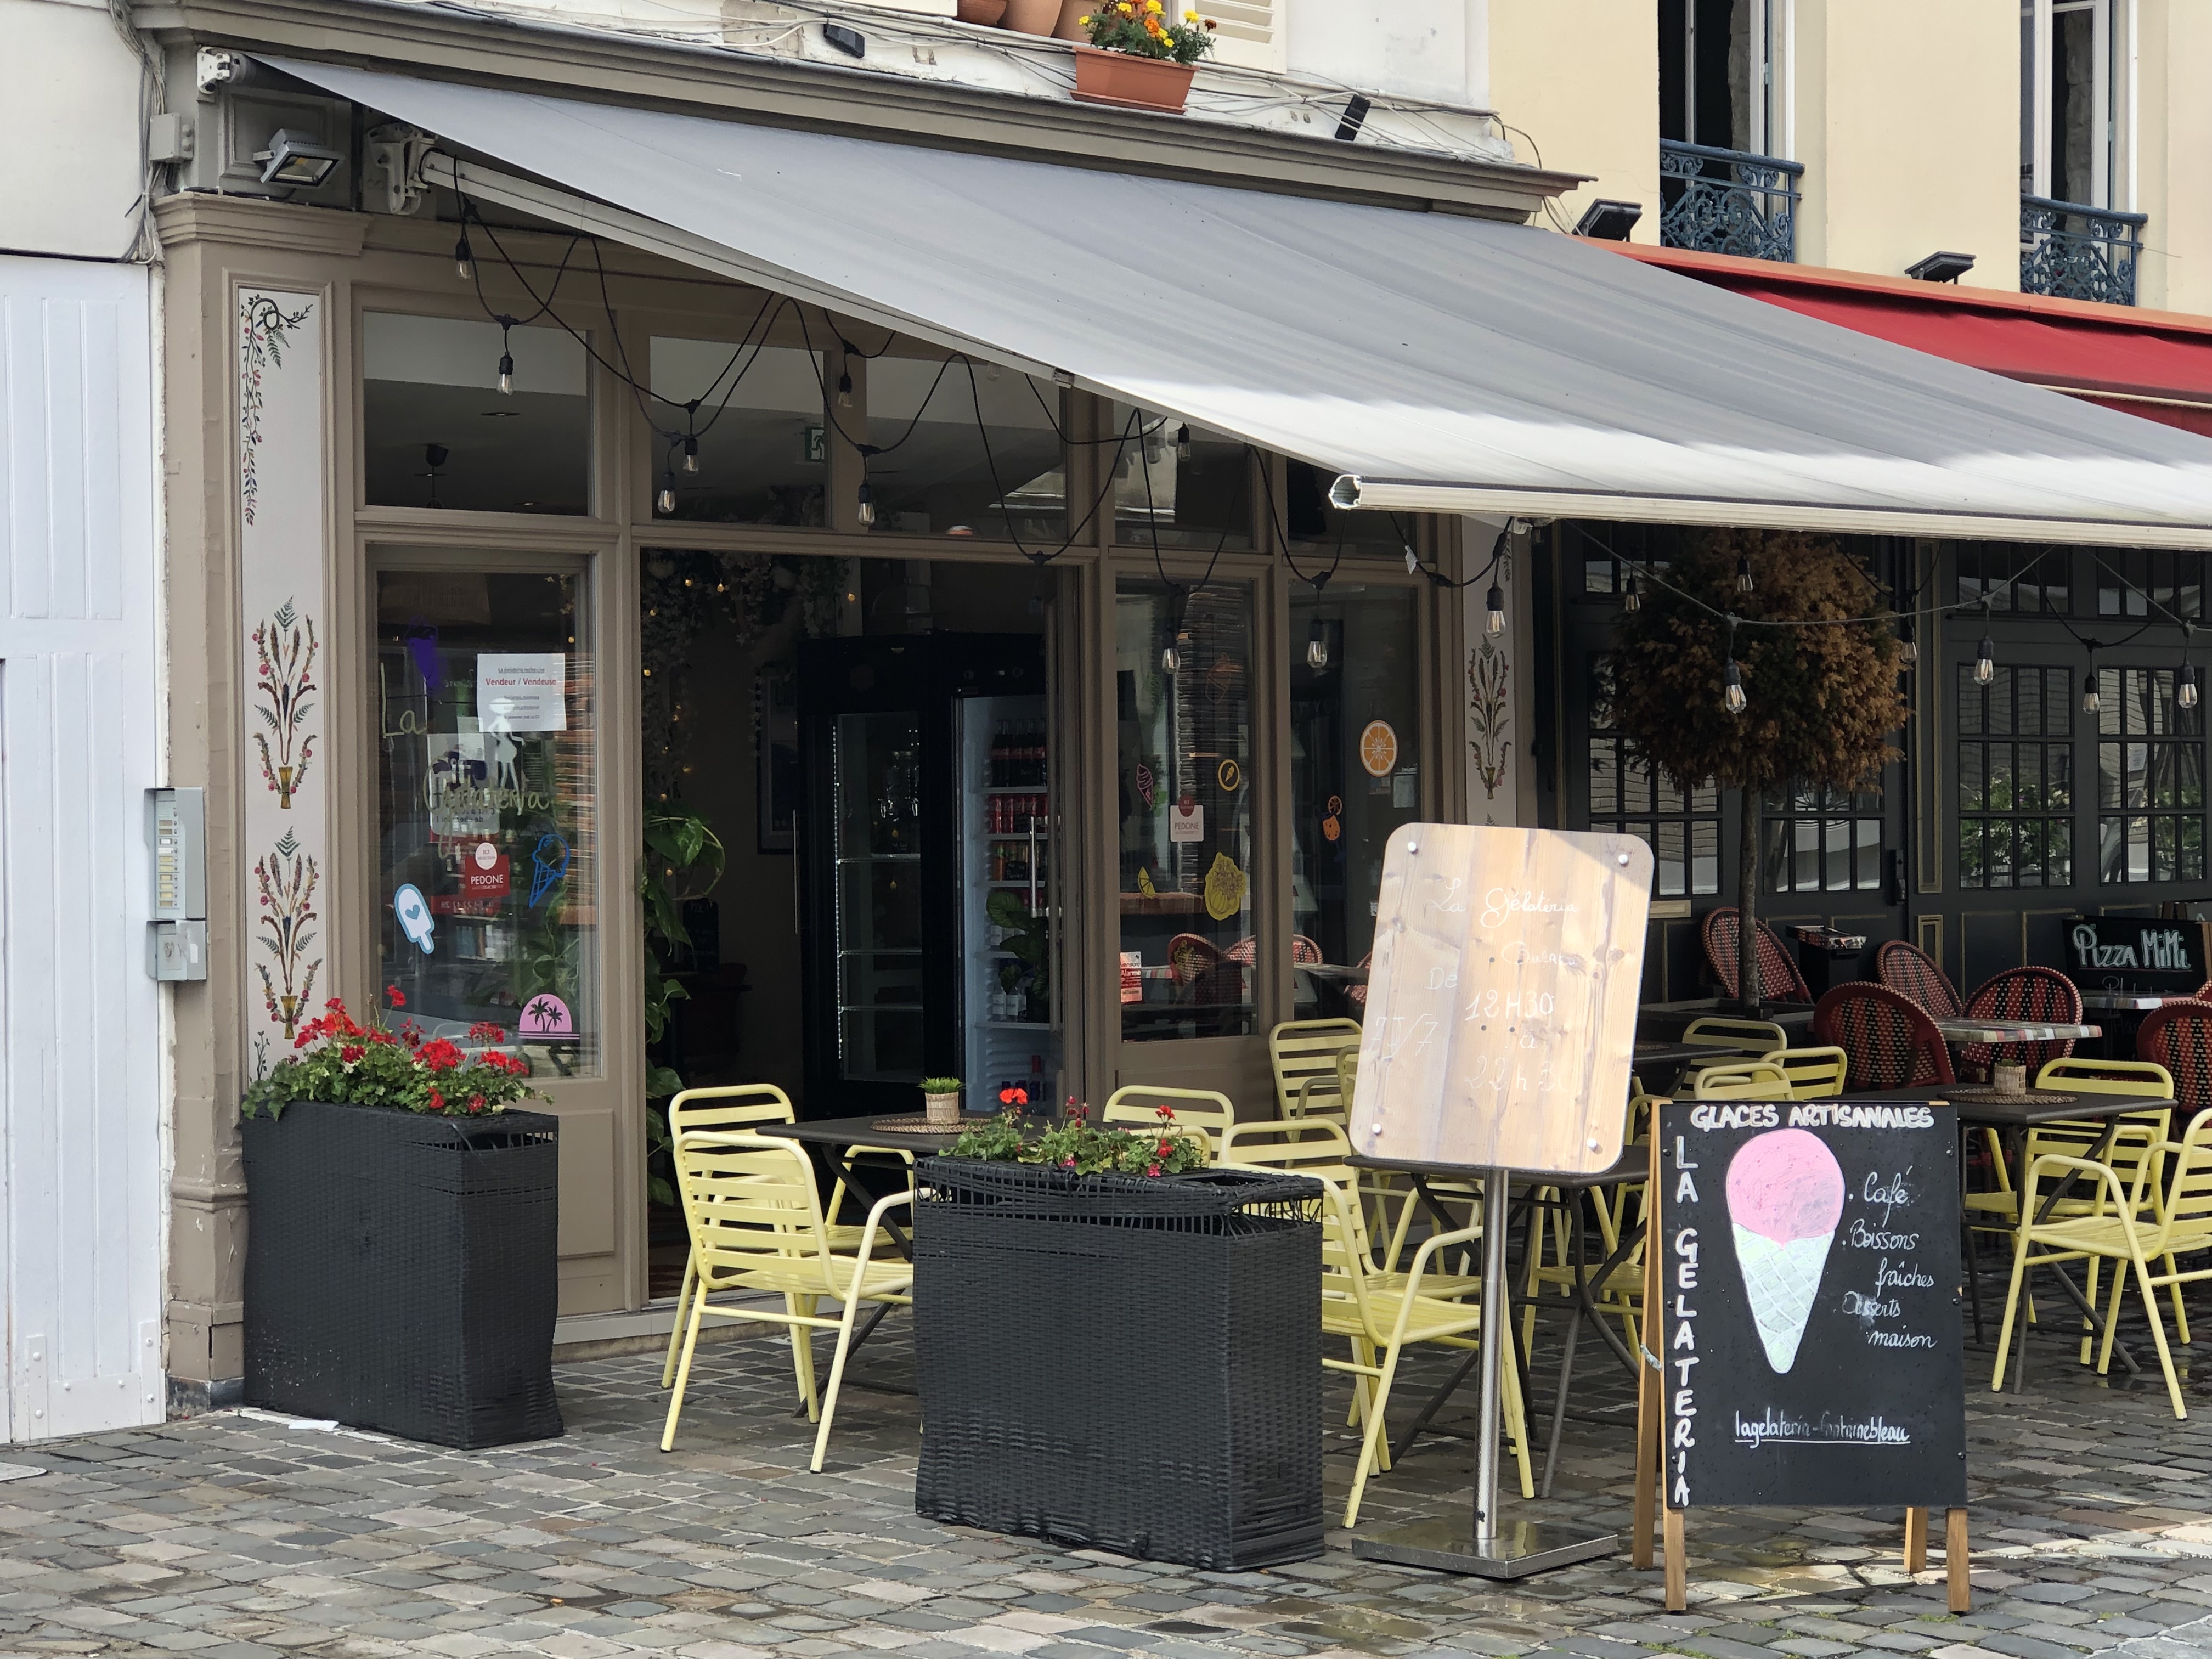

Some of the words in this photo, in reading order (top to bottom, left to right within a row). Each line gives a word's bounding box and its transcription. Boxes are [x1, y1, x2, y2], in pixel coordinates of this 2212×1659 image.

[380, 662, 427, 739] La
[471, 874, 504, 885] PEDONE
[1426, 878, 1466, 912] La
[1425, 967, 1458, 990] De
[1464, 989, 1555, 1021] 12H30
[1690, 1104, 1780, 1132] GLACES
[1787, 1104, 1935, 1128] ARTISANALES
[1675, 1135, 1700, 1204] LA
[1864, 1165, 1914, 1228] Café
[1849, 1218, 1920, 1250] Boissons
[1875, 1257, 1934, 1299] fraîches
[1866, 1324, 1938, 1348] maison
[1674, 1228, 1701, 1507] GELATERIA
